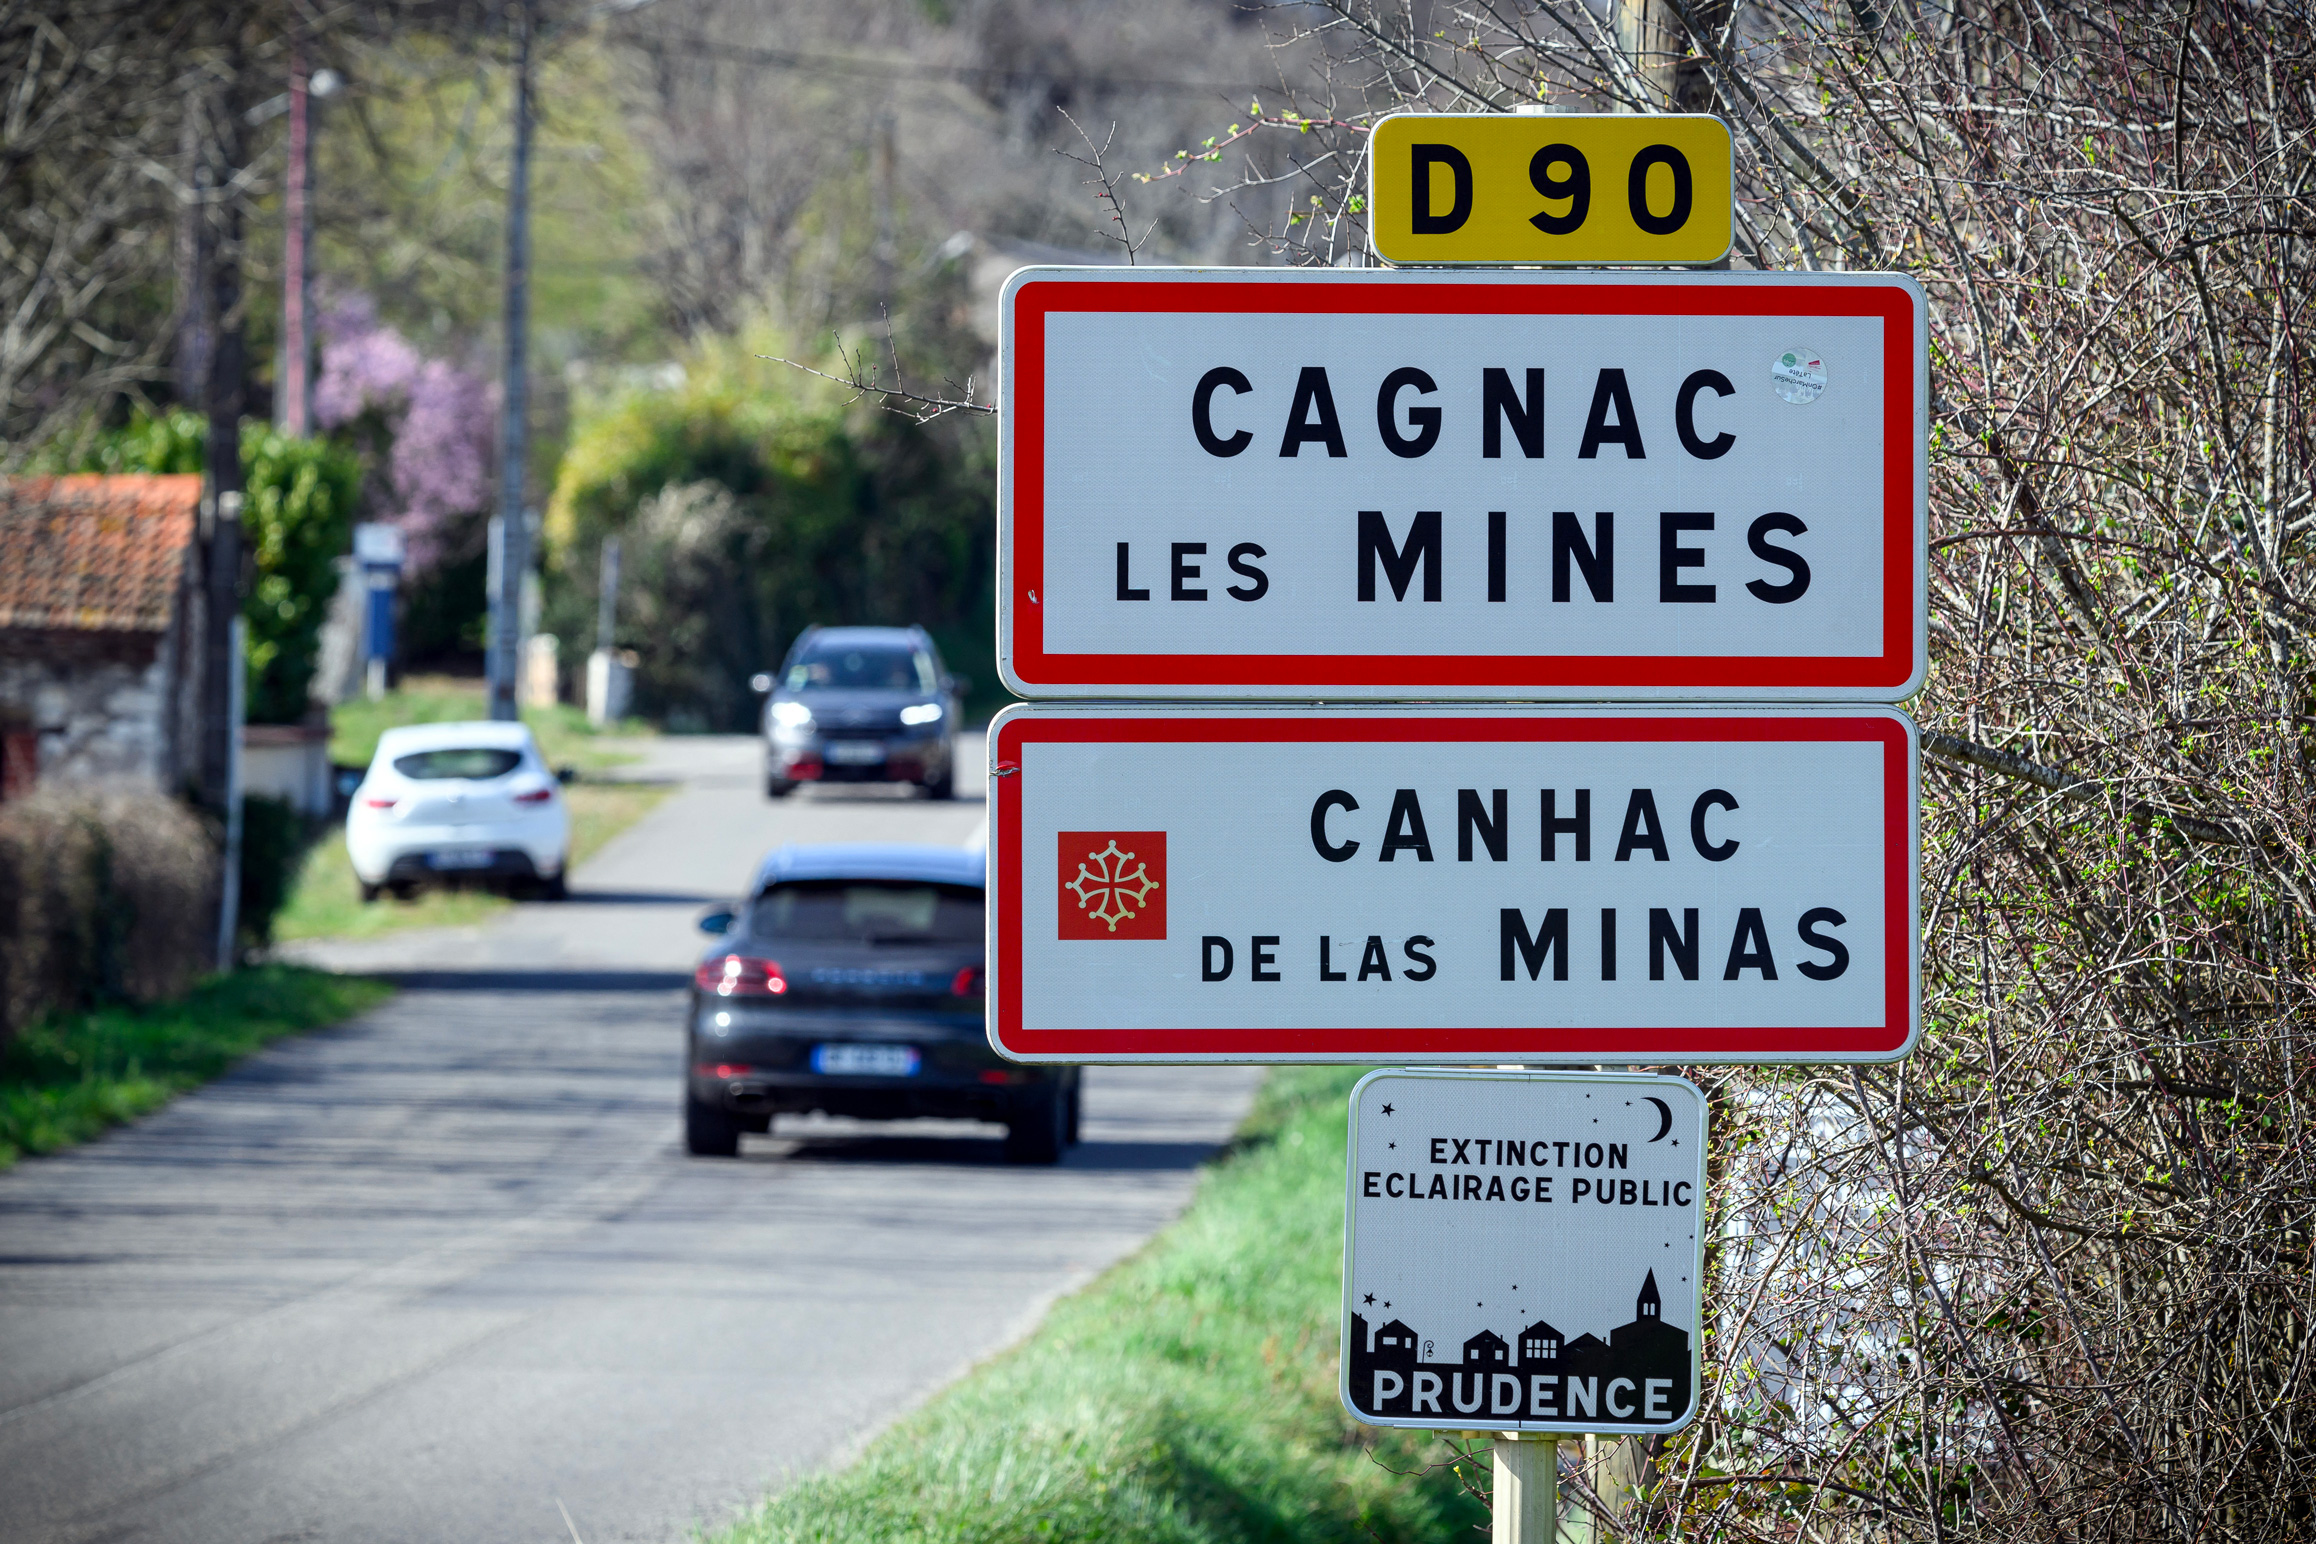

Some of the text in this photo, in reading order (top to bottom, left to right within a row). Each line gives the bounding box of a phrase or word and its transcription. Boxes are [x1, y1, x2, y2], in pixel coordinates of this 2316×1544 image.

[1411, 143, 1693, 235] D 90
[1192, 367, 1736, 460] CAGNAC
[1117, 511, 1811, 604] LES MINES
[1311, 789, 1741, 862] CANHAC
[1202, 907, 1850, 982] DE LAS MINAS
[1363, 1172, 1692, 1207] ECLAIRAGE PUBLIC
[1430, 1138, 1628, 1169] EXTINCTION
[1373, 1369, 1673, 1420] PRUDENCE
